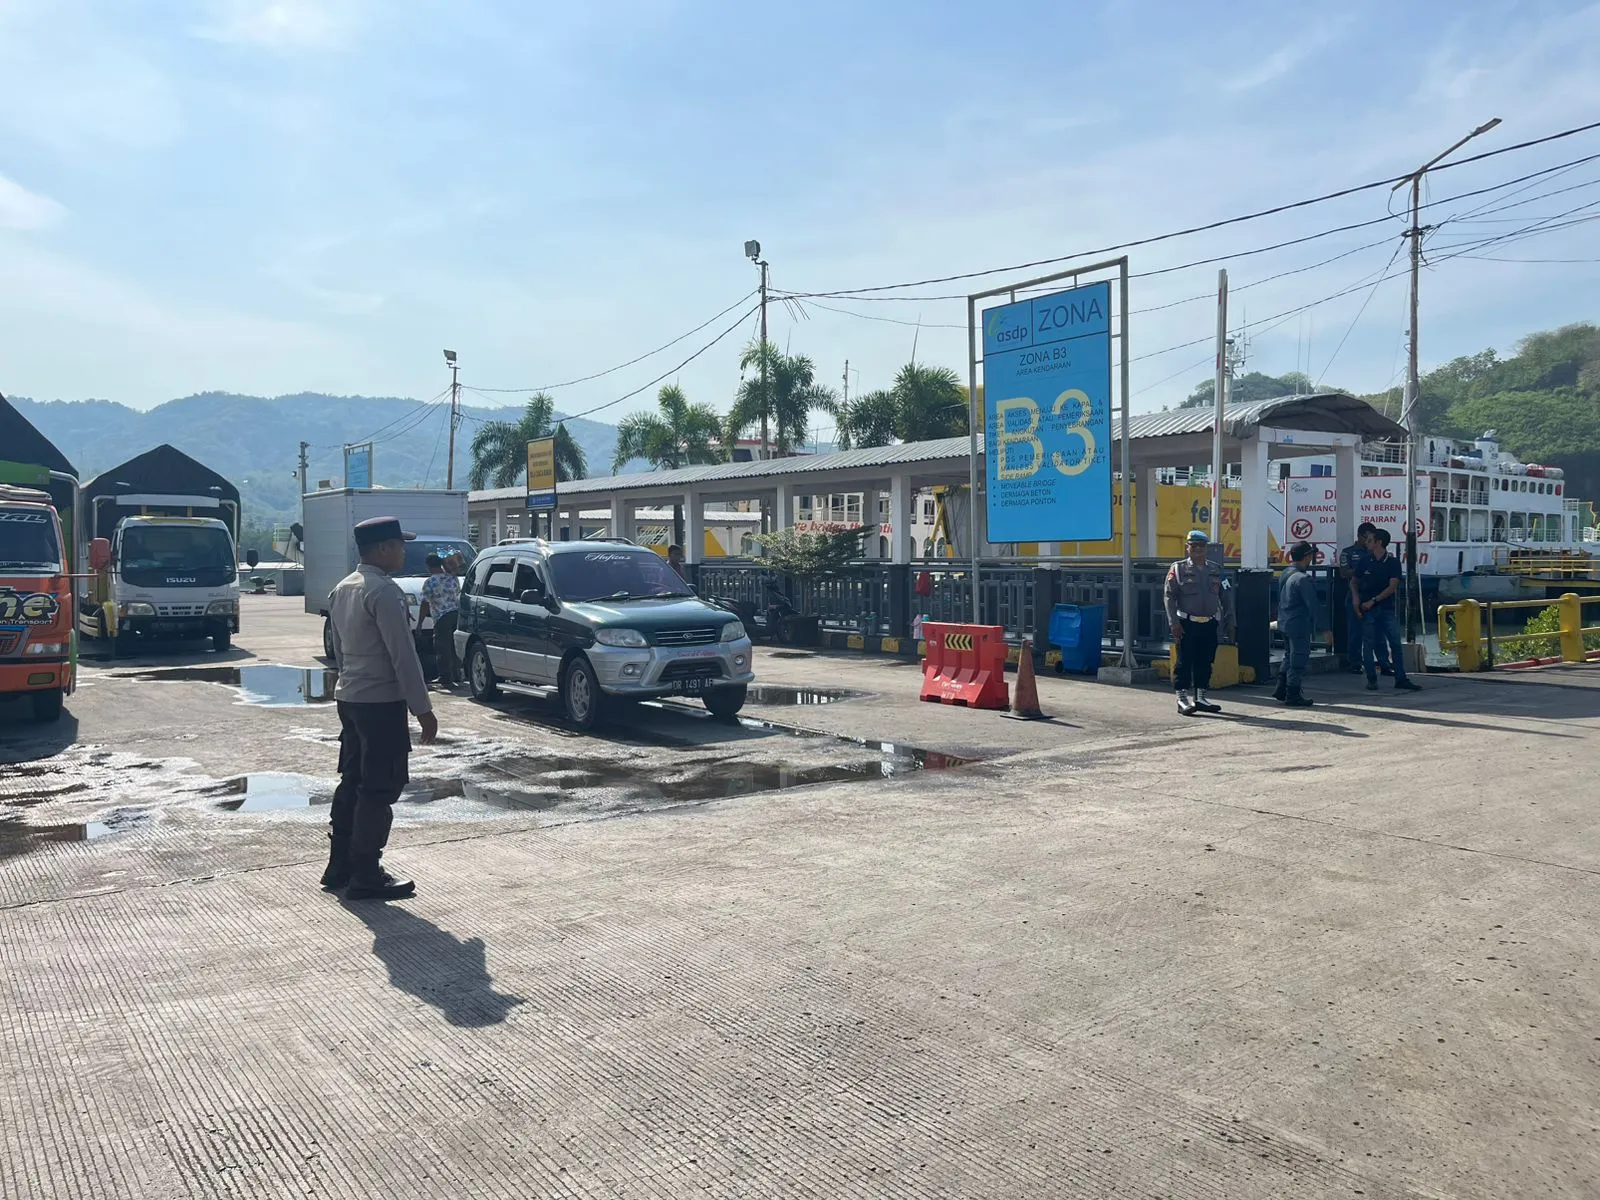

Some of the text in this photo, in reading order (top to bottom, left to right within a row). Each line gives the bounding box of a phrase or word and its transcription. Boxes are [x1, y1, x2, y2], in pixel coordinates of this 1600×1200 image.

[1038, 298, 1103, 332] ZONA
[997, 326, 1027, 342] asdp
[1020, 347, 1066, 366] ZONA B3
[1016, 361, 1071, 376] AREA KENDARAAN
[996, 389, 1095, 480] B3
[1030, 488, 1050, 496] BETON
[1030, 496, 1056, 505] PONTON
